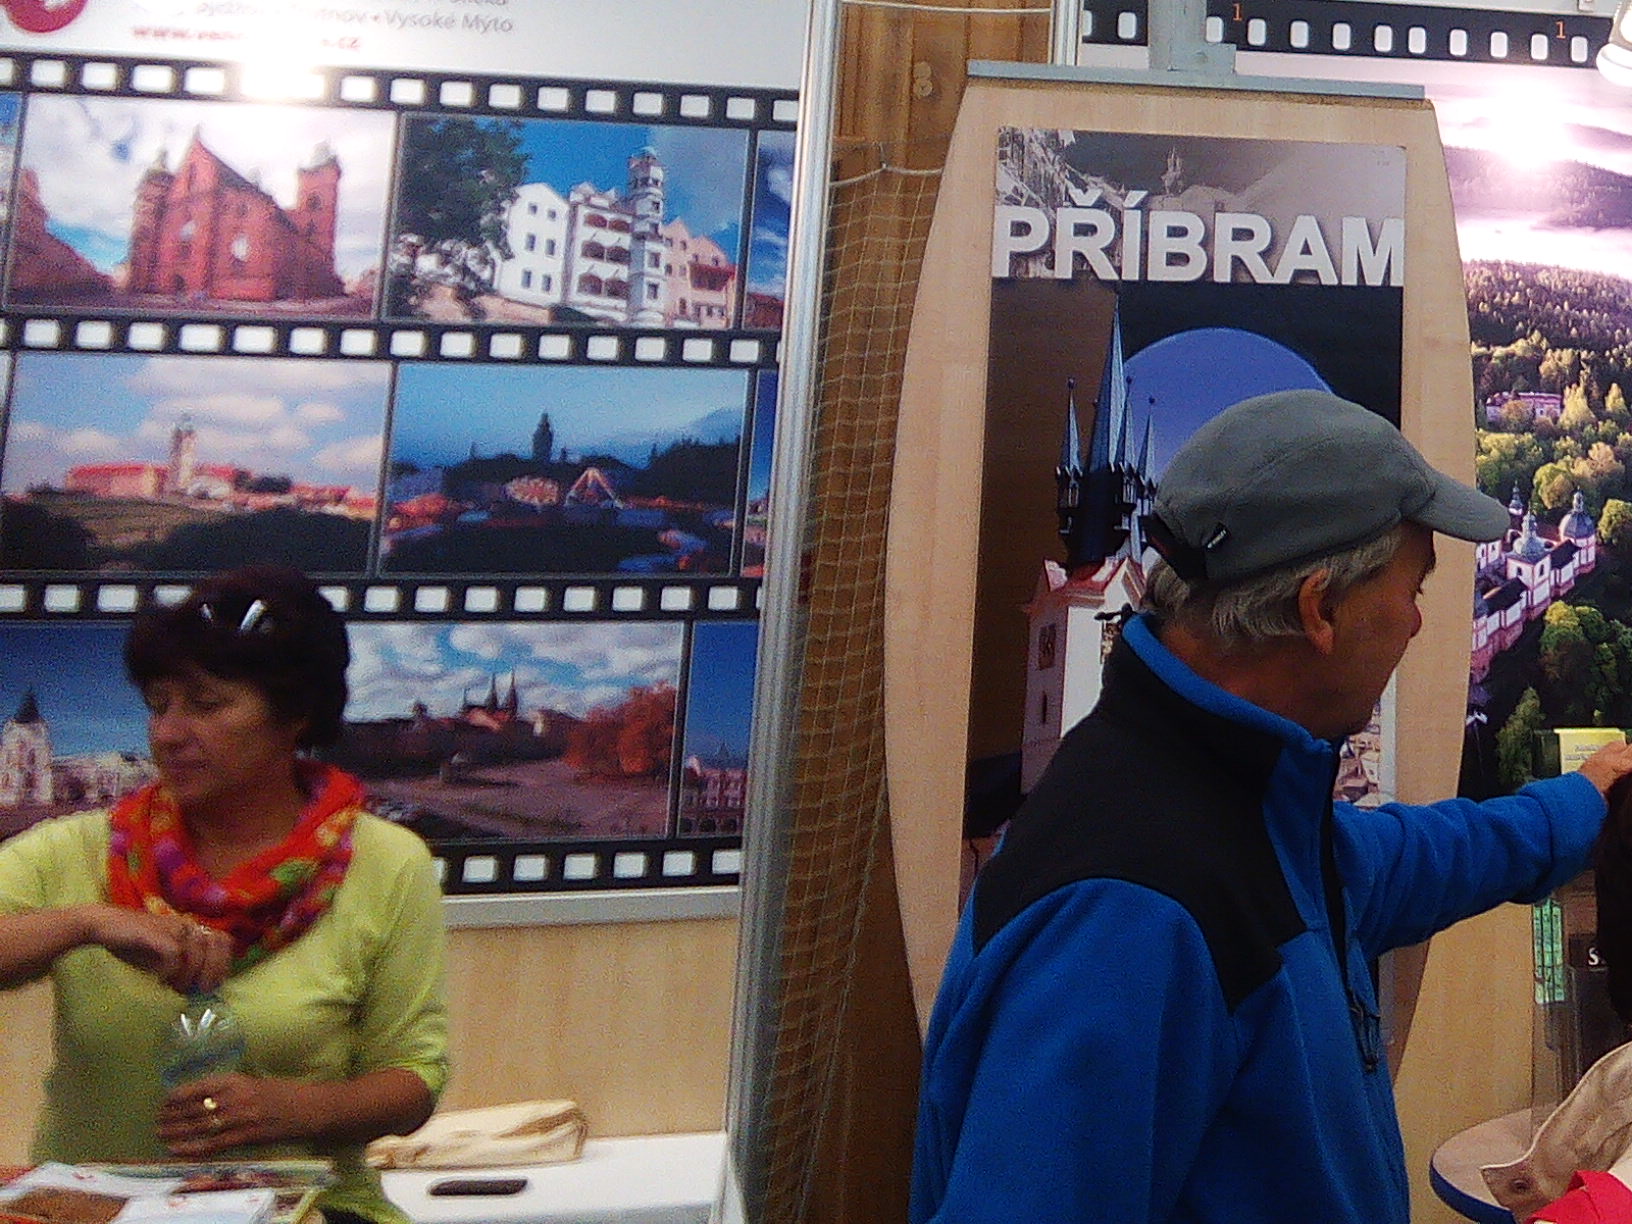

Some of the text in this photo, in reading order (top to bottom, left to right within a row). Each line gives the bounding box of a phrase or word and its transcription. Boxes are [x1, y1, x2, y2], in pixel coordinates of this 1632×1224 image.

[384, 9, 456, 31] Vysoké
[461, 13, 514, 34] Mýto
[1233, 3, 1243, 22] 1
[1555, 21, 1566, 40] 1
[992, 188, 1405, 287] PŘÍBRAM
